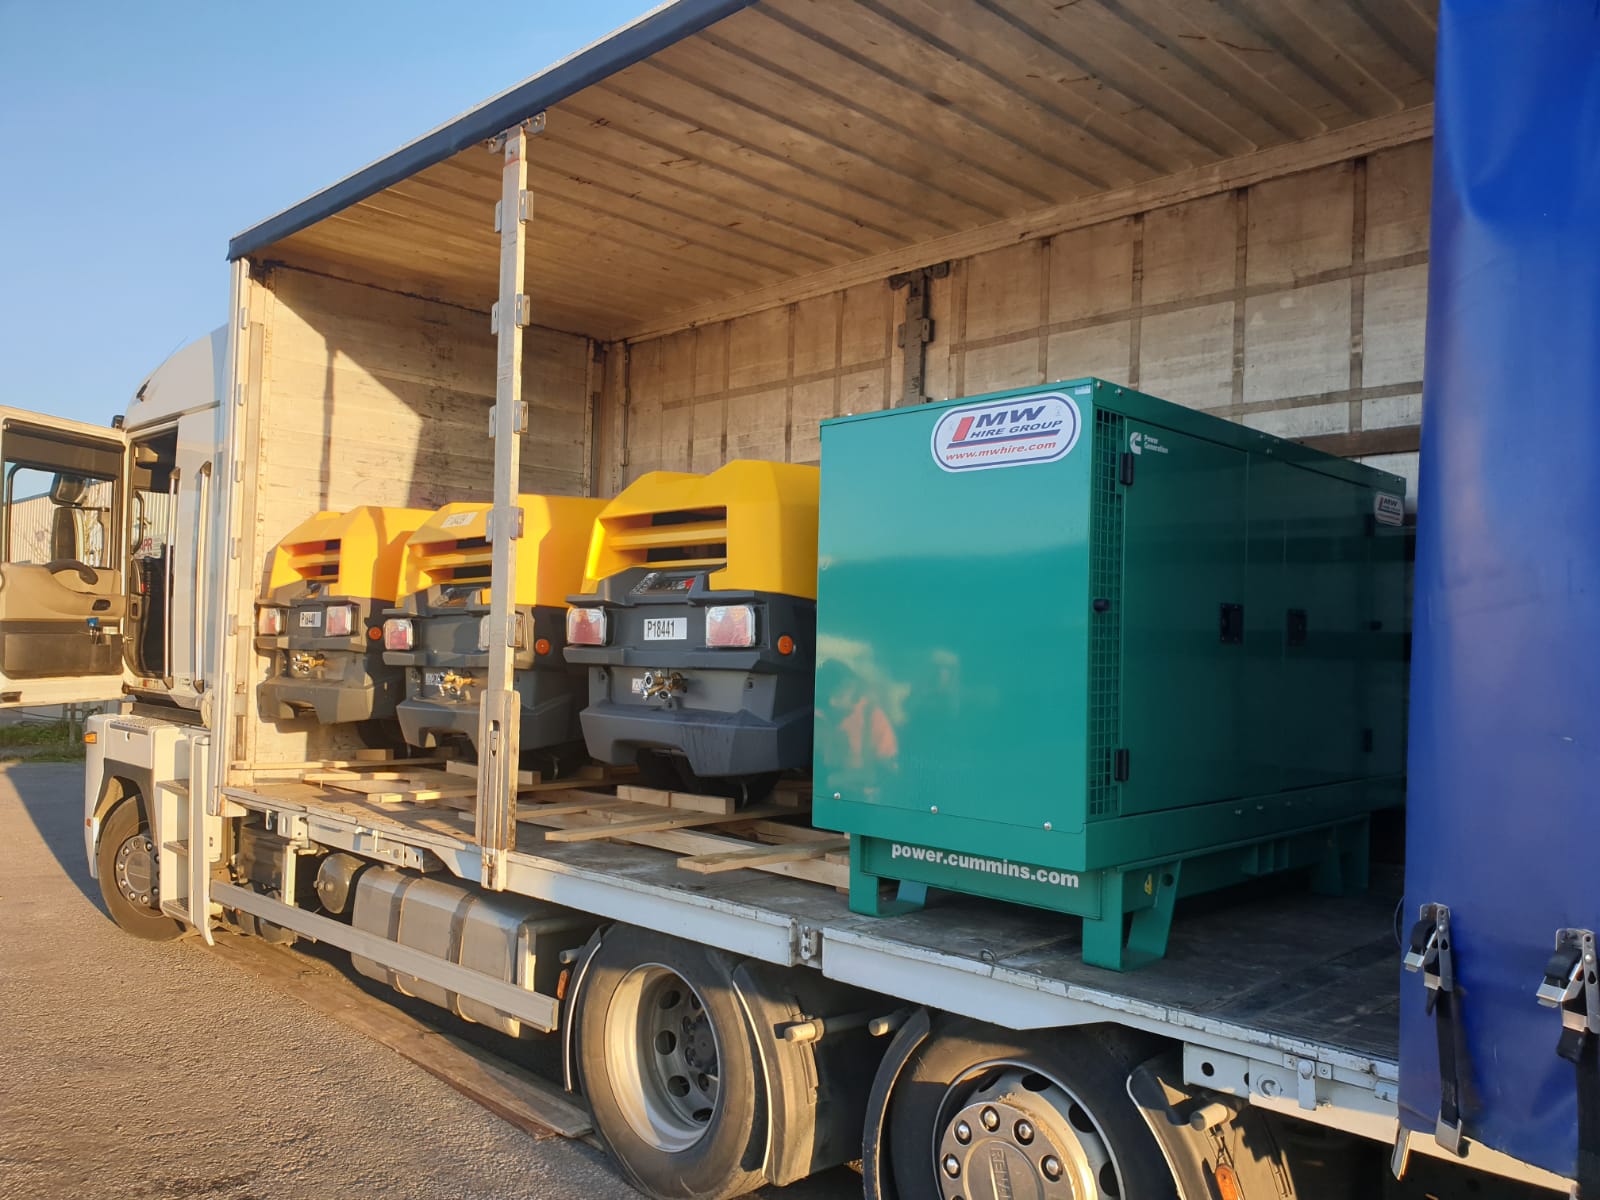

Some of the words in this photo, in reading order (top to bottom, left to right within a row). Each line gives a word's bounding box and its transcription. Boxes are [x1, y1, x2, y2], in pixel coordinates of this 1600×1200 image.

[976, 406, 1046, 428] MW
[970, 427, 1006, 439] HIRE
[1009, 420, 1063, 434] GROUP
[945, 441, 1057, 461] www.mwhire.com
[647, 620, 675, 638] P18441
[891, 843, 1080, 889] power.cummins.com
